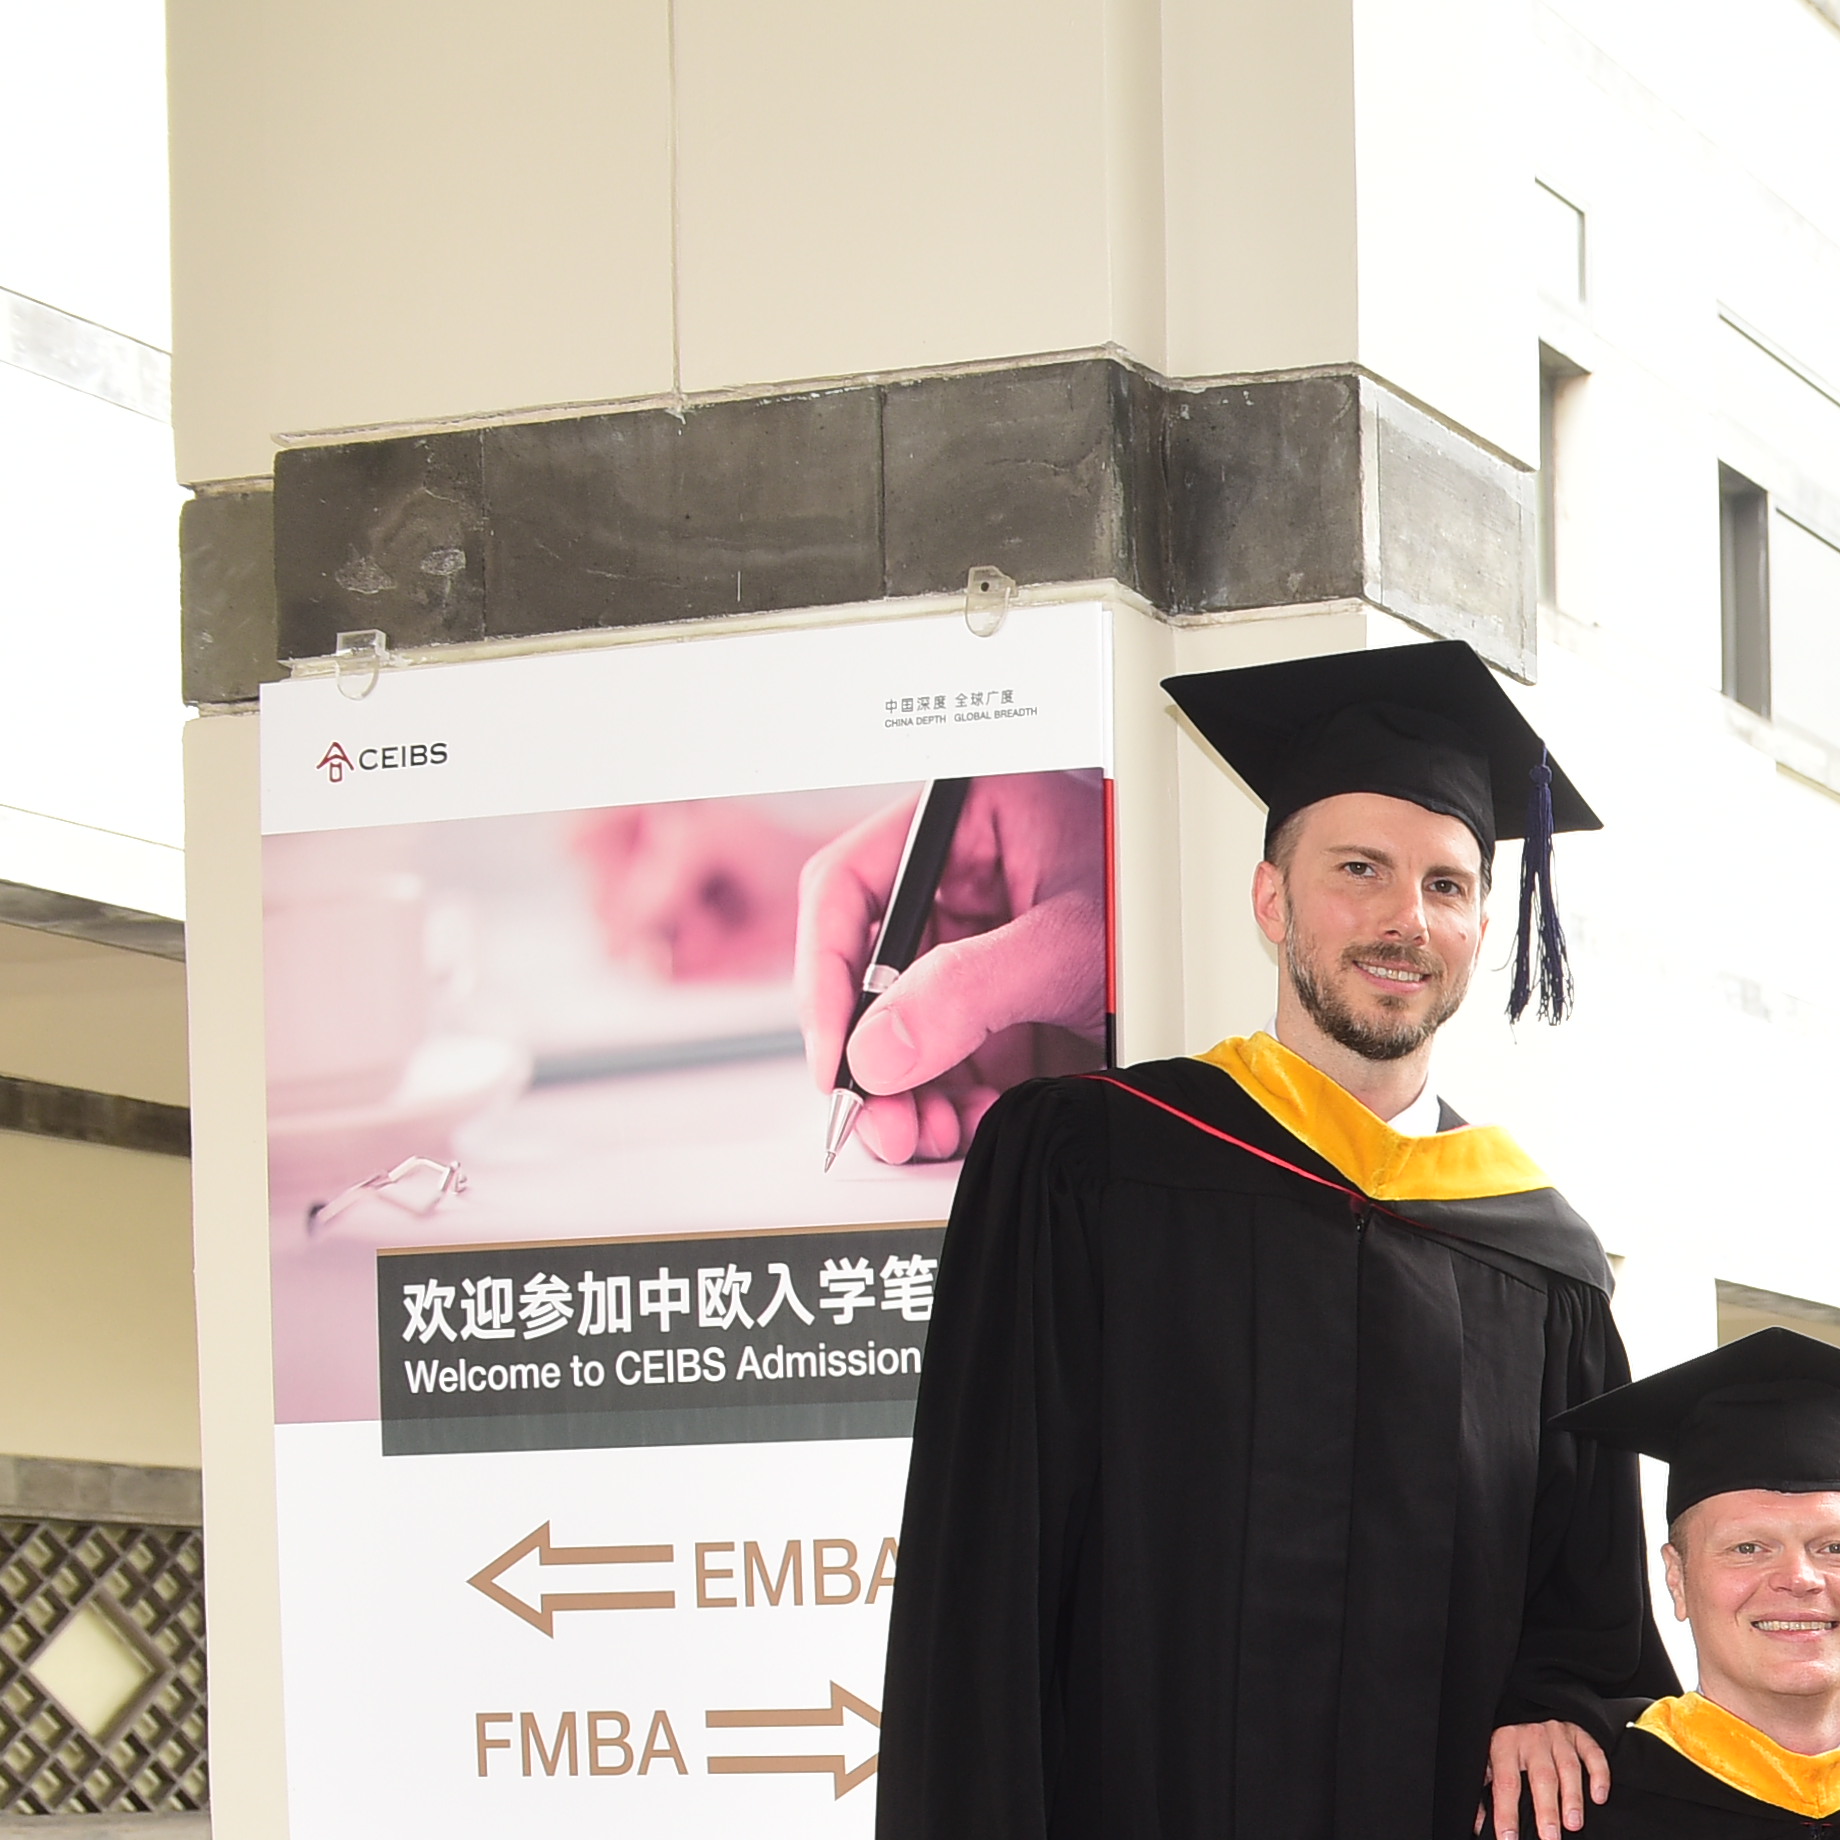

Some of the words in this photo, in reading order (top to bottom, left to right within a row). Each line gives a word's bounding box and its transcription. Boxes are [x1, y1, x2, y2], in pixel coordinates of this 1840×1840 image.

[885, 695, 947, 714] 中国深度
[955, 689, 1015, 708] 全球广度
[885, 717, 914, 728] CHINA
[916, 714, 947, 726] DEPTH
[954, 710, 992, 722] GLOBAL
[994, 706, 1038, 719] BREADTH
[358, 742, 449, 771] CEIBS
[402, 1254, 938, 1344] 欢迎参加中欧入学笔
[404, 1356, 561, 1394] Welcome
[570, 1354, 605, 1387] to
[615, 1345, 727, 1386] CEIBS
[736, 1340, 922, 1381] Admission
[694, 1536, 902, 1609] EMBA
[475, 1709, 689, 1778] FMBA
